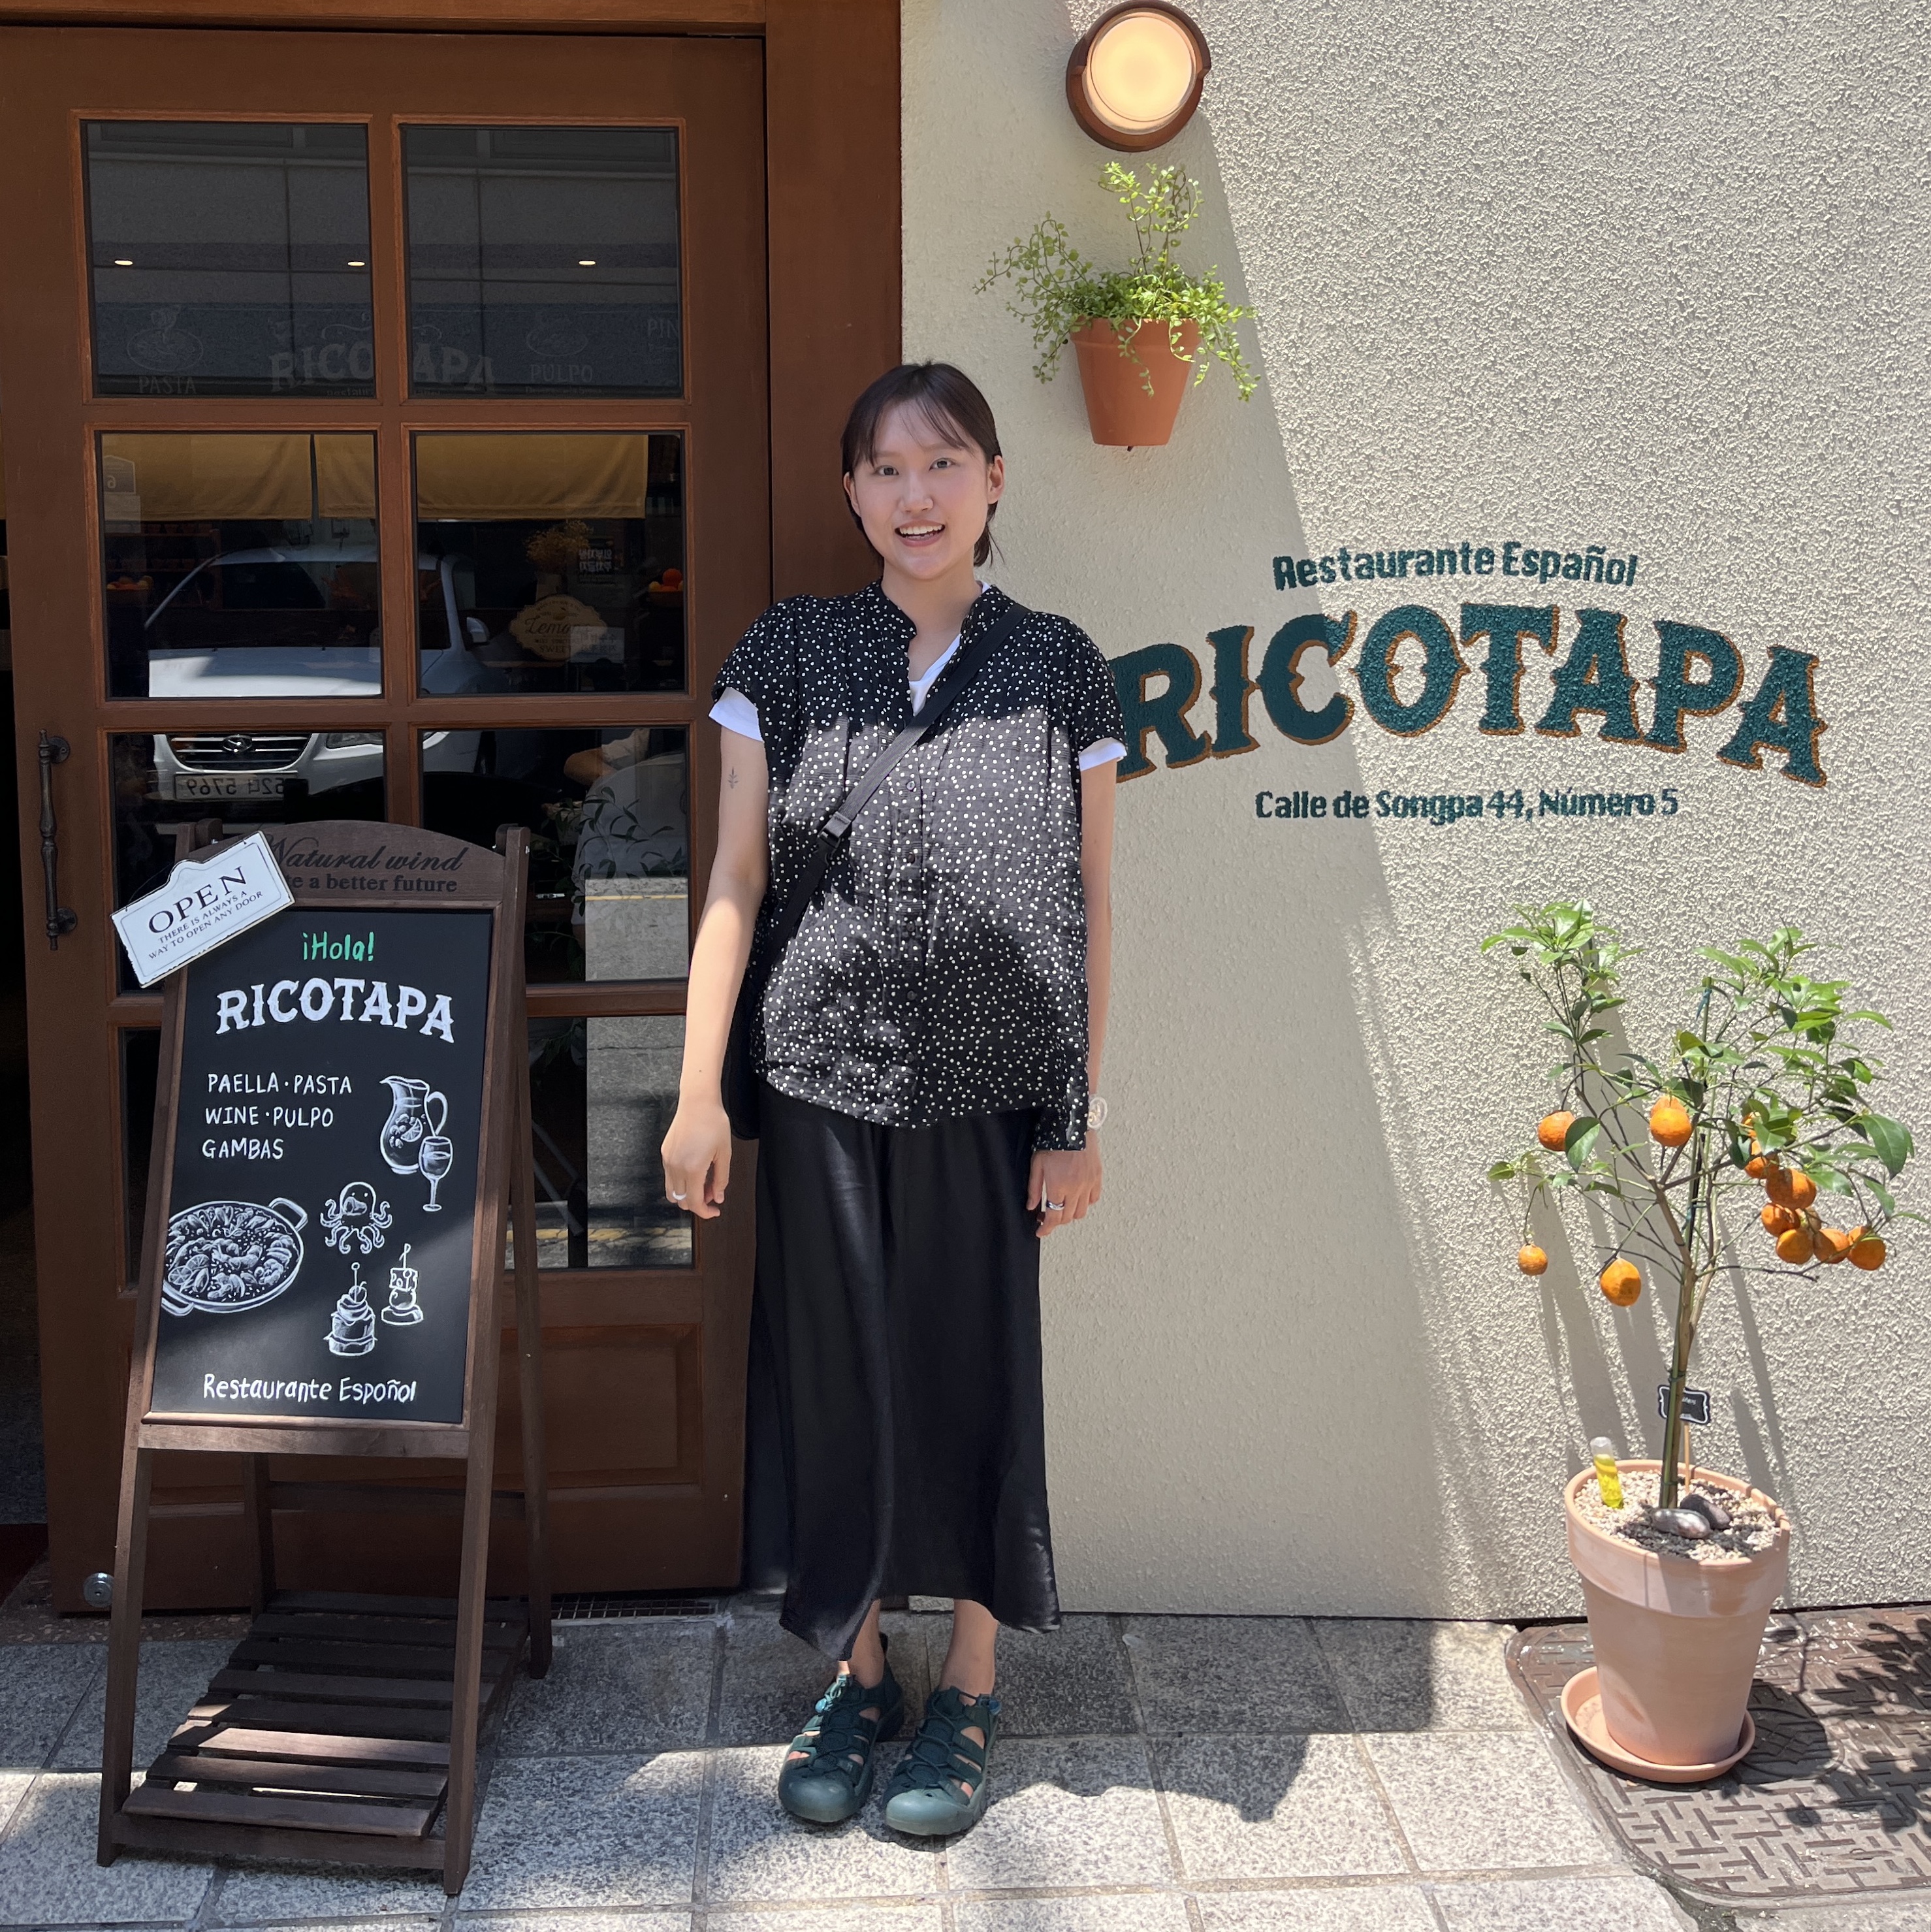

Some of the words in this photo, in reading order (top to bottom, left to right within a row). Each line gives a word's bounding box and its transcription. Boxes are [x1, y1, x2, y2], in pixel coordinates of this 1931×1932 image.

[138, 375, 197, 394] PASTA
[530, 363, 594, 383] PULPO
[1272, 541, 1495, 590] Restaurante
[1502, 541, 1638, 587] Español
[1108, 602, 1826, 788] RICOTAPA
[1255, 791, 1326, 818] Calle
[1333, 791, 1369, 818] de
[1375, 790, 1484, 825] Songpa
[1539, 786, 1655, 818] Número
[1661, 788, 1679, 816] 5
[386, 847, 469, 871] wind
[149, 866, 246, 933] OPEN
[309, 876, 320, 889] a
[327, 874, 388, 891] better
[392, 875, 457, 892] future
[148, 944, 168, 959] WAY
[171, 936, 184, 947] TO
[186, 921, 212, 939] OPEN
[214, 909, 232, 923] ANY
[235, 891, 263, 910] DOOR
[159, 923, 189, 944] THERE
[191, 917, 200, 926] IS
[202, 895, 238, 920] ALWAYS
[215, 977, 455, 1044] RICOTAPA
[202, 1136, 284, 1160] GAMBAS
[203, 1373, 332, 1402] Restaurante
